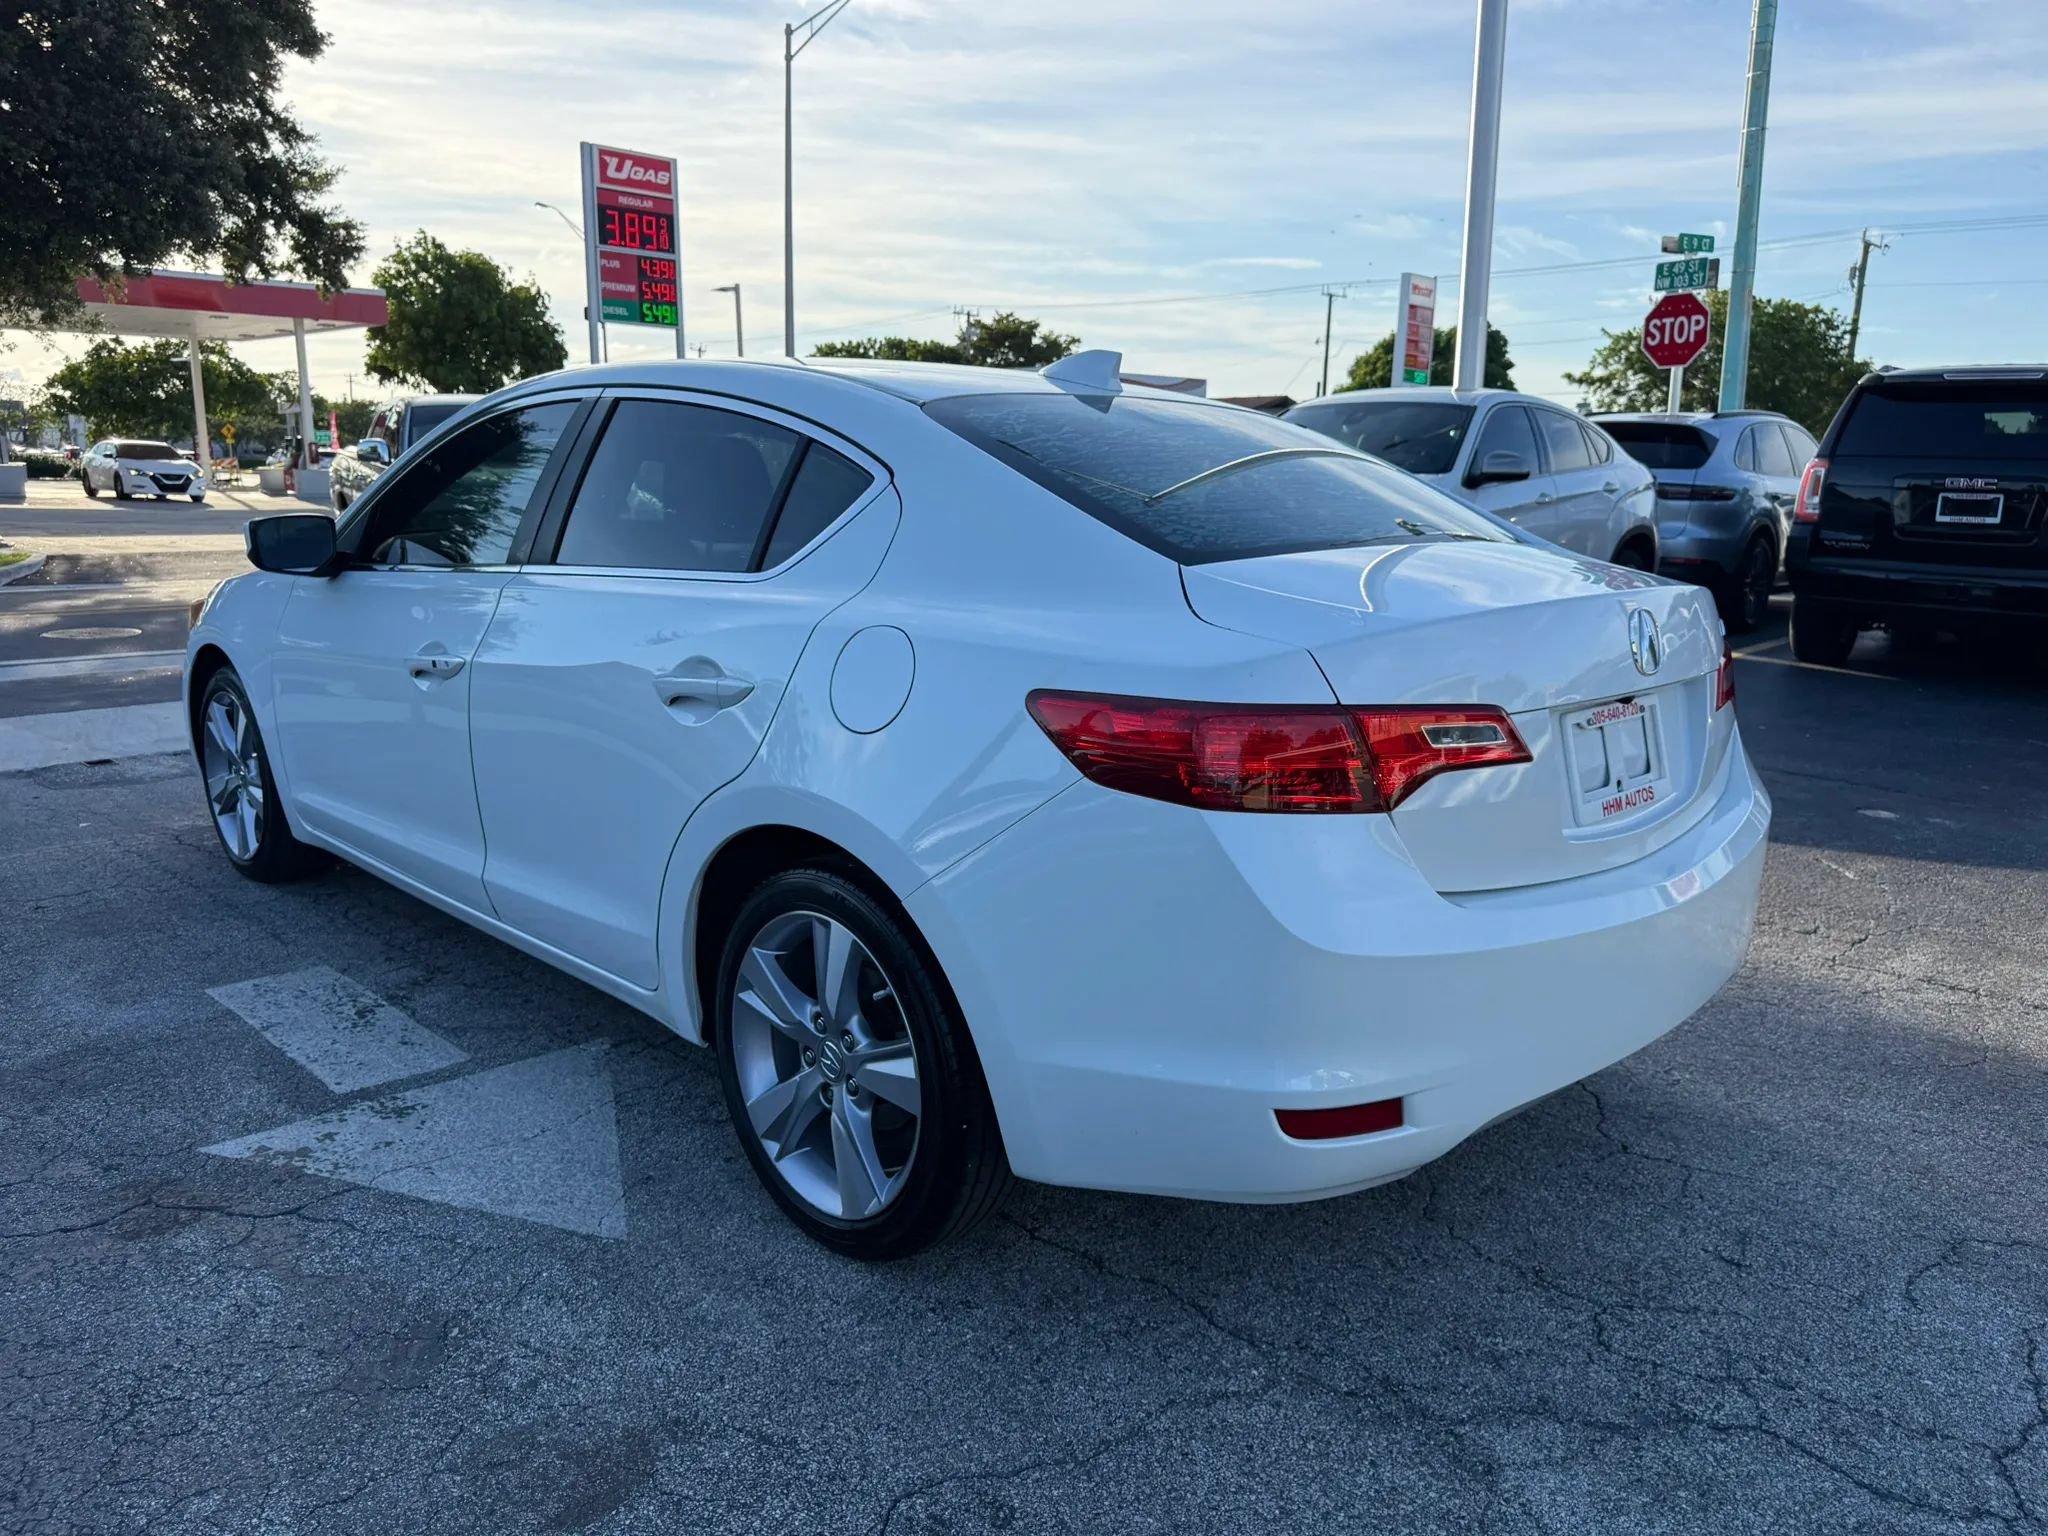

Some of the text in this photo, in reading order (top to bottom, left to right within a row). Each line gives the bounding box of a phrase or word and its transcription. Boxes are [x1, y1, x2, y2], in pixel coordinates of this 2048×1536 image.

[618, 196, 653, 209] REGULAR
[1683, 236, 1710, 250] E 9 CT
[601, 259, 620, 270] PLUS
[1663, 260, 1699, 276] E 49 ST
[601, 281, 636, 293] PREMIUM
[1657, 272, 1704, 289] NW 103 ST
[602, 304, 629, 317] DIESEL
[1647, 314, 1705, 346] STOP
[1945, 477, 1998, 489] GMC
[1602, 786, 1654, 817] HHM AUTOS
